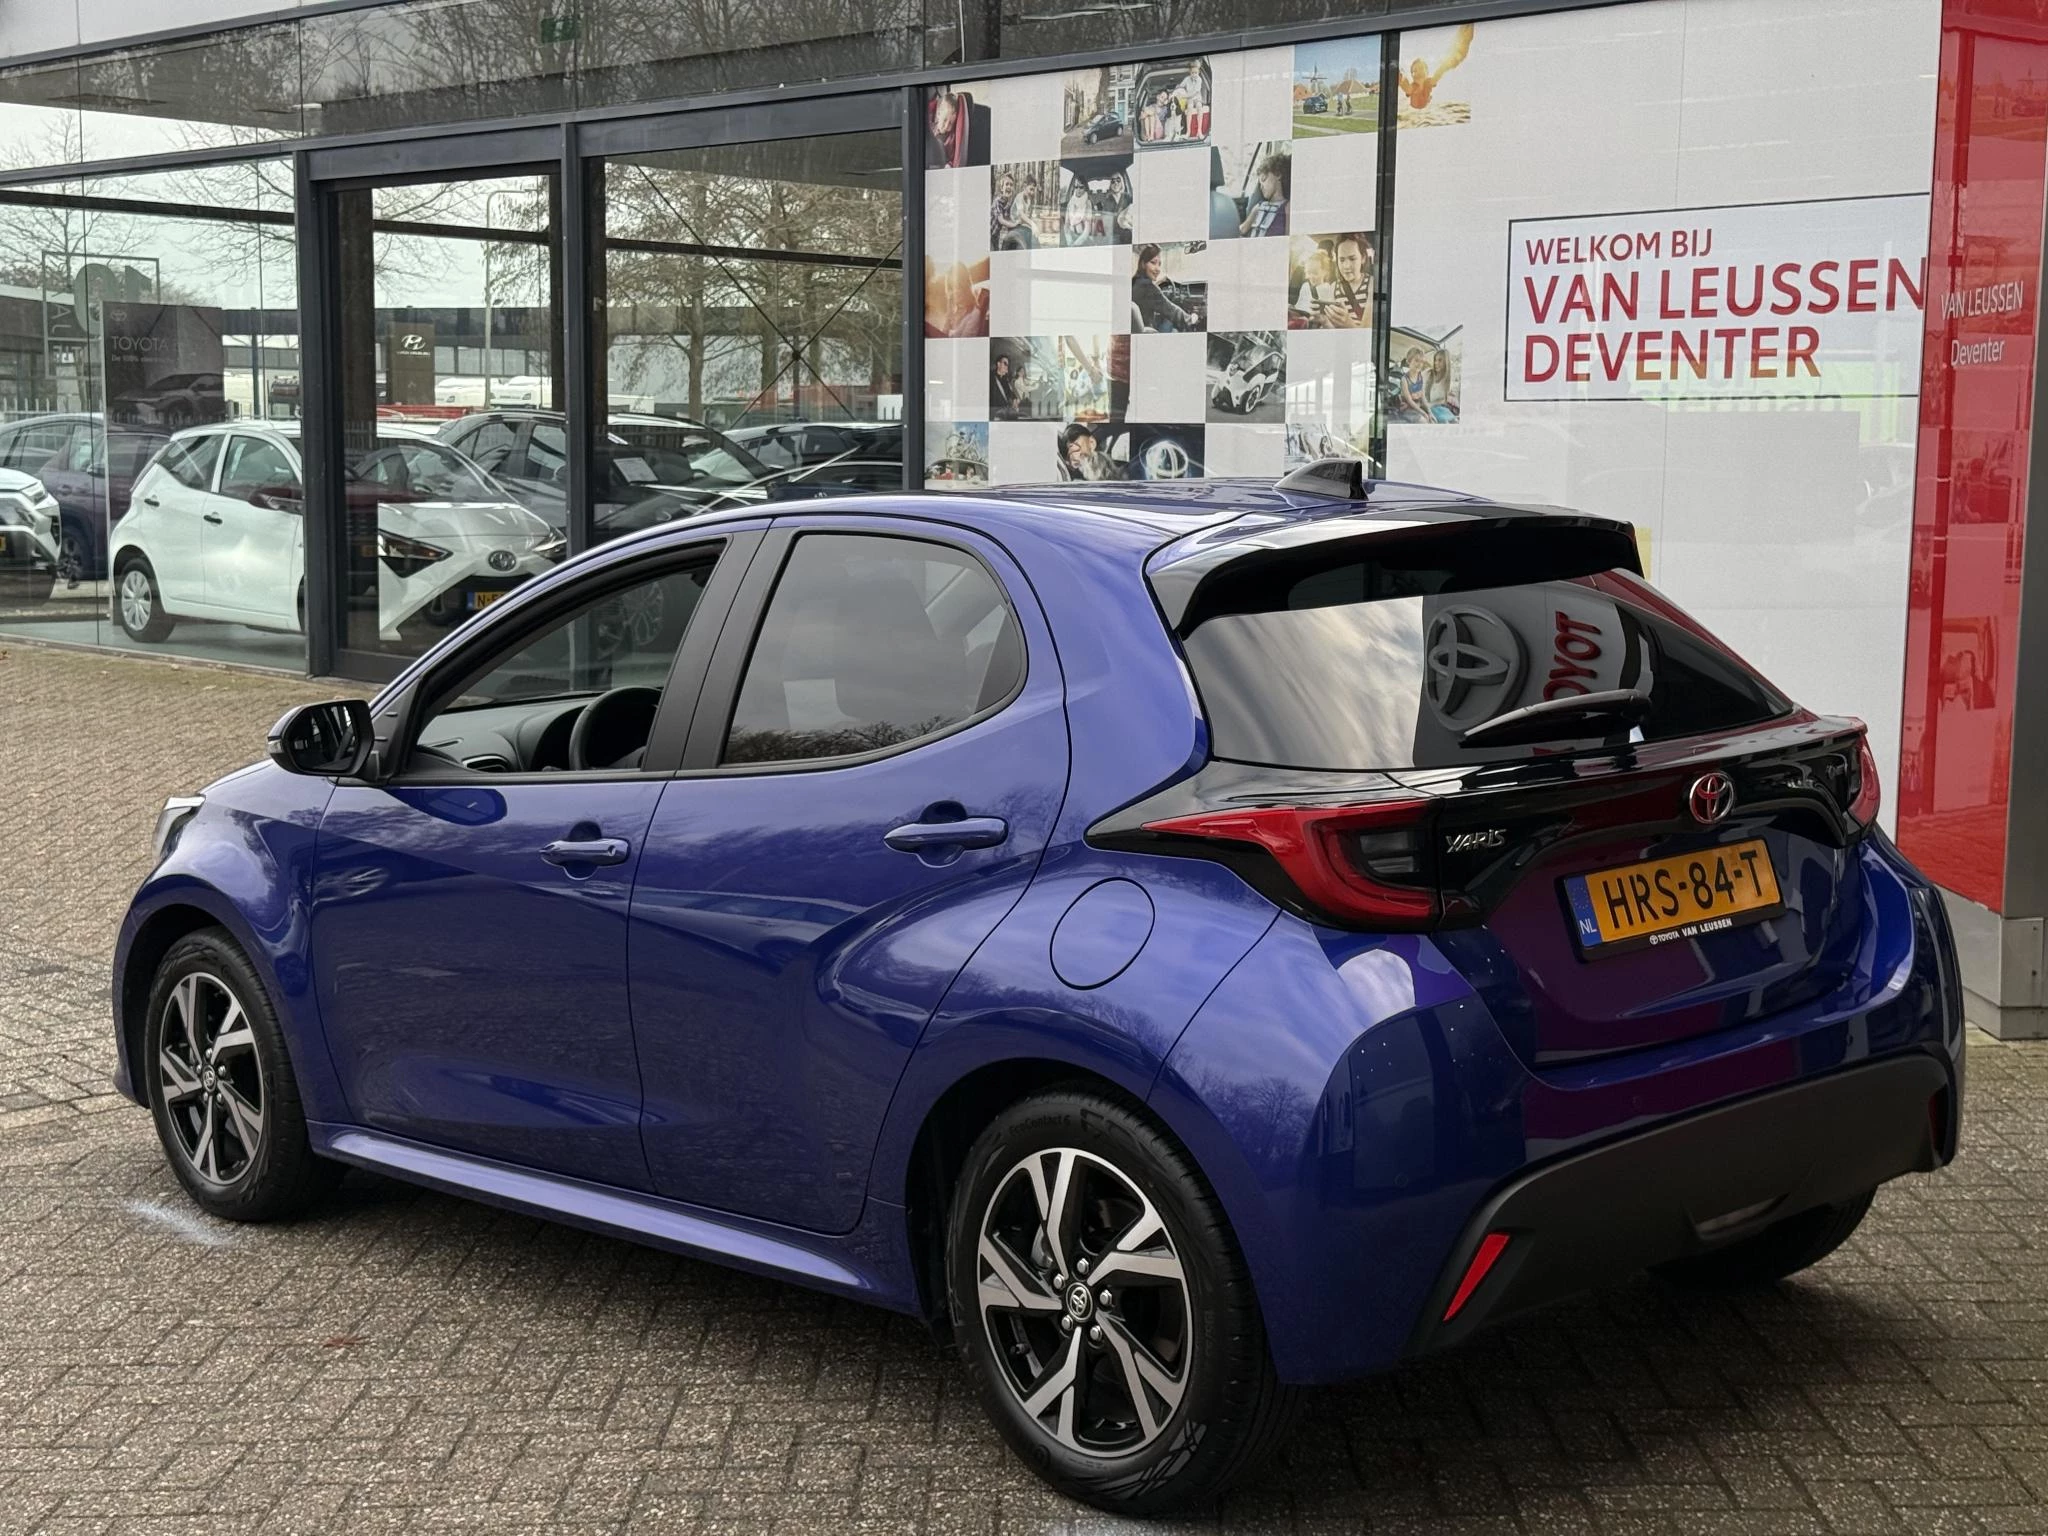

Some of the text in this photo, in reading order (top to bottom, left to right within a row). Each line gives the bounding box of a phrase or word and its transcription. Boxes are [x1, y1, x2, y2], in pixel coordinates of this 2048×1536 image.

[1525, 228, 1713, 266] WELKOM BIJ
[1523, 256, 1927, 324] VAN LEUSSEN
[1940, 280, 2024, 320] VAN LEUSSEN
[111, 335, 169, 352] TOYOTA
[1524, 326, 1822, 382] DEVENTER
[1950, 337, 2005, 367] Deventer
[1445, 829, 1507, 853] YARIS
[1602, 849, 1758, 929] HRS-84-T
[1580, 918, 1598, 935] NL
[1657, 918, 1733, 943] TOYOTA VAN LEUSSEN
